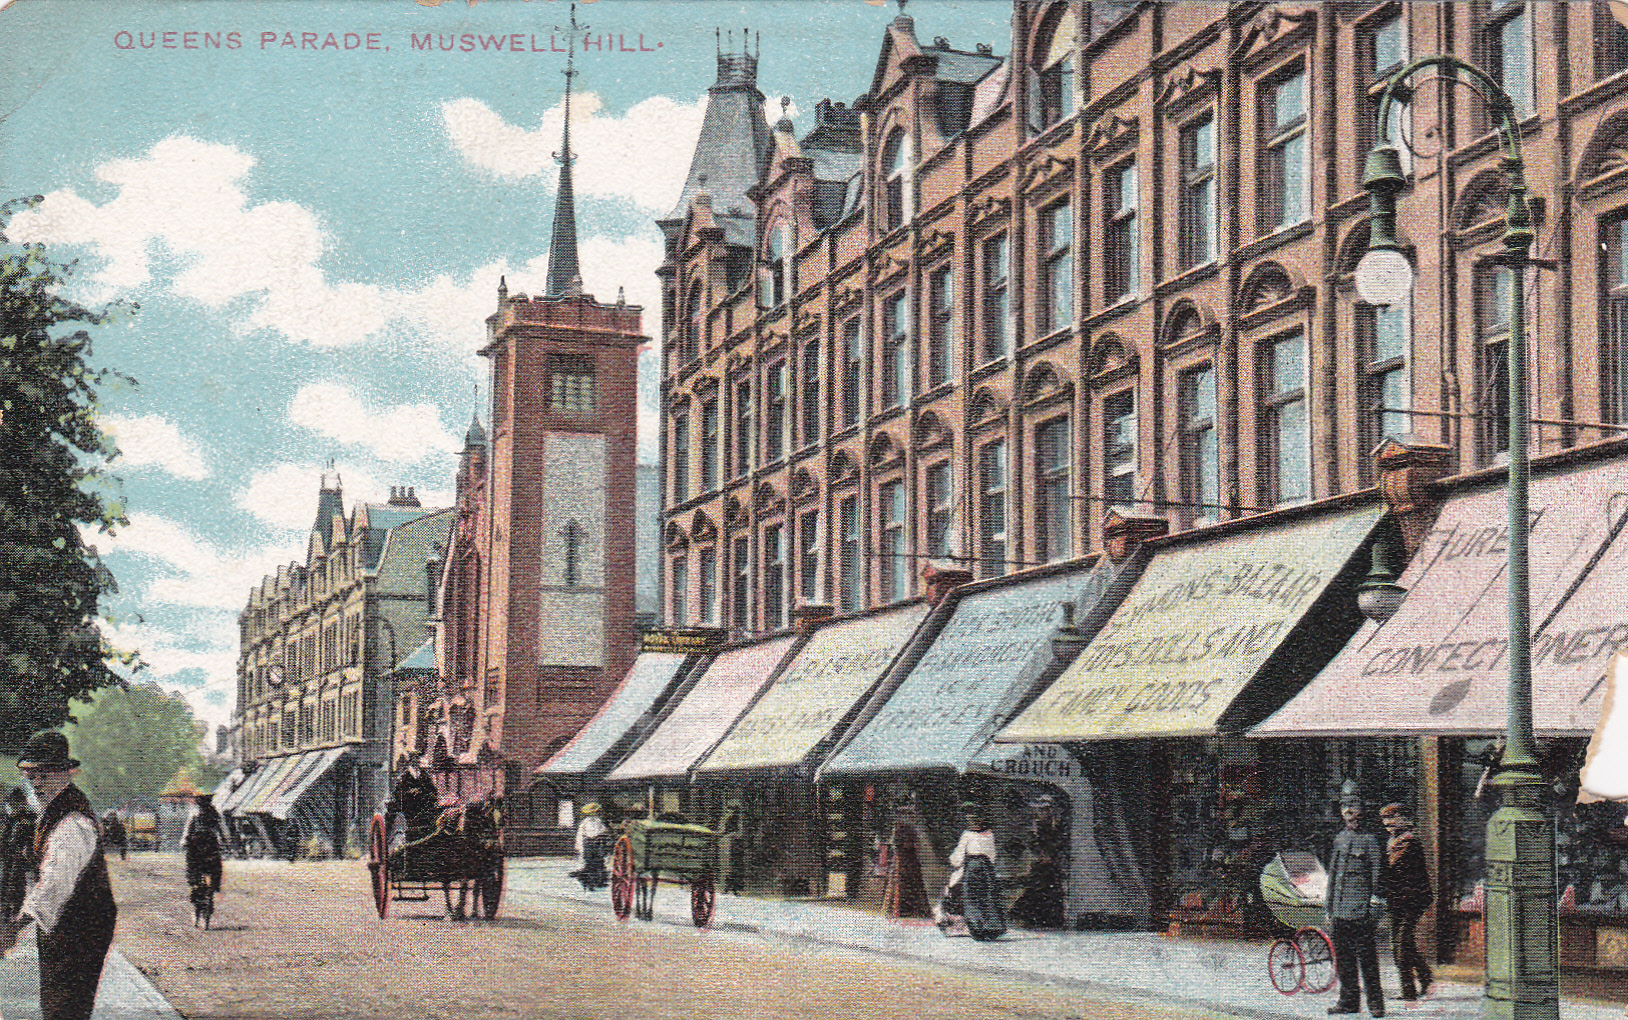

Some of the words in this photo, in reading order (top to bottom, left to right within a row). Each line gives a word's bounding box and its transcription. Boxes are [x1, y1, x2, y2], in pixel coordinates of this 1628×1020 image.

[1224, 562, 1322, 612] BAZAAR
[1133, 626, 1225, 666] DOLLS
[1215, 620, 1284, 659] AND
[1125, 677, 1224, 714] GOODS
[990, 758, 1071, 778] CROUCH
[1022, 744, 1058, 759] AND
